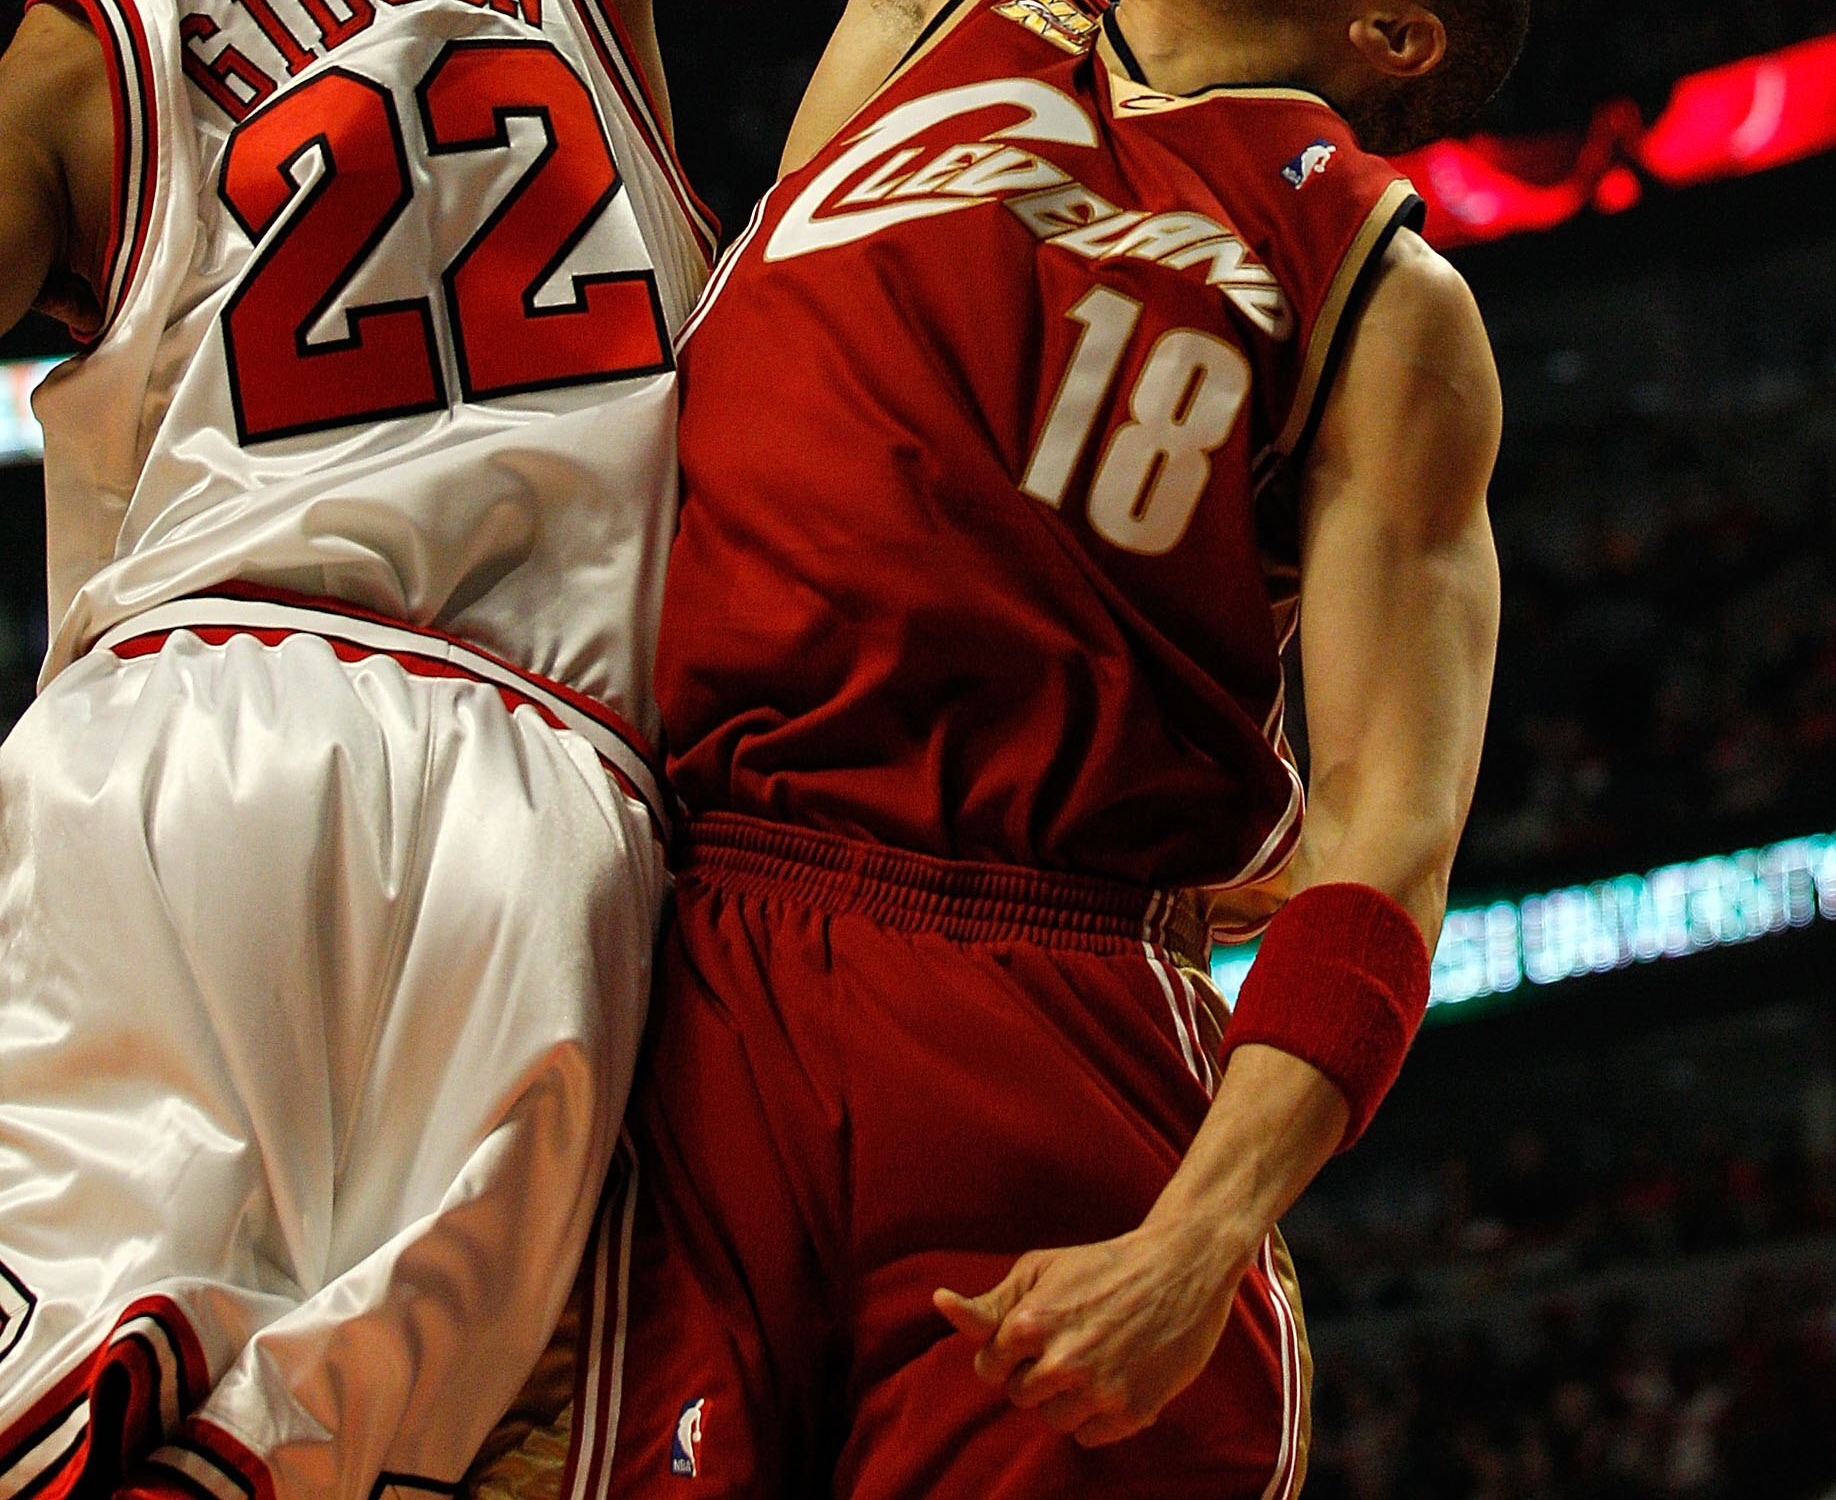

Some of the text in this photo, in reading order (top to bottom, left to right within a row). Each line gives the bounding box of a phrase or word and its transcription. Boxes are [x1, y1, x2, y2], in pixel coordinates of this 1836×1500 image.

[219, 39, 676, 447] 22
[763, 77, 1294, 342] CLEVELAND
[1018, 283, 1253, 557] 18
